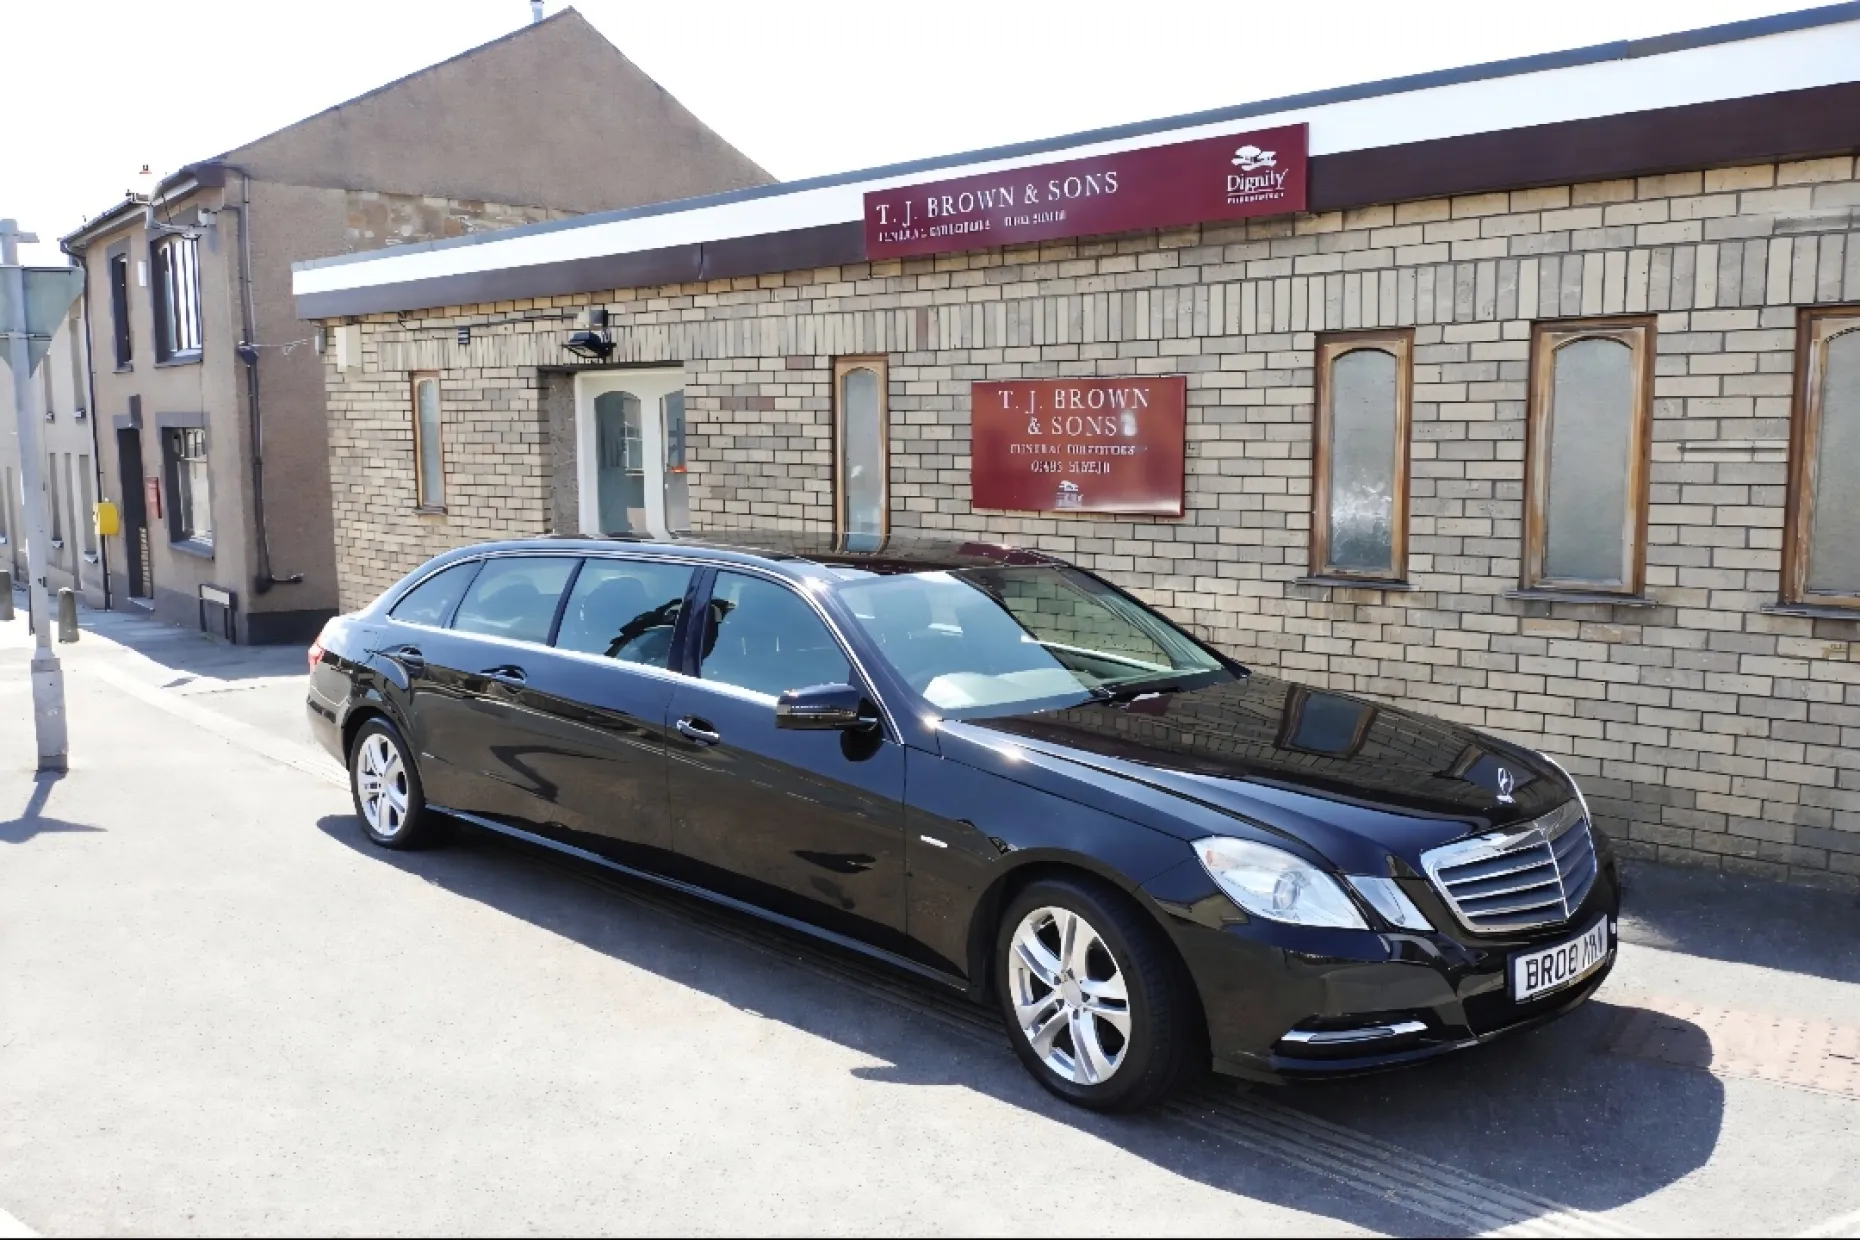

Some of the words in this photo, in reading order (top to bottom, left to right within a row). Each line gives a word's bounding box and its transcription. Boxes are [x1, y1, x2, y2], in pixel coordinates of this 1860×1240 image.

[1227, 168, 1289, 193] Dignity
[927, 185, 1015, 218] BROWN
[1024, 184, 1040, 204] &
[1048, 171, 1119, 201] SONS
[1054, 388, 1150, 409] BROWN
[1027, 416, 1043, 435] &
[1051, 416, 1118, 436] SONS
